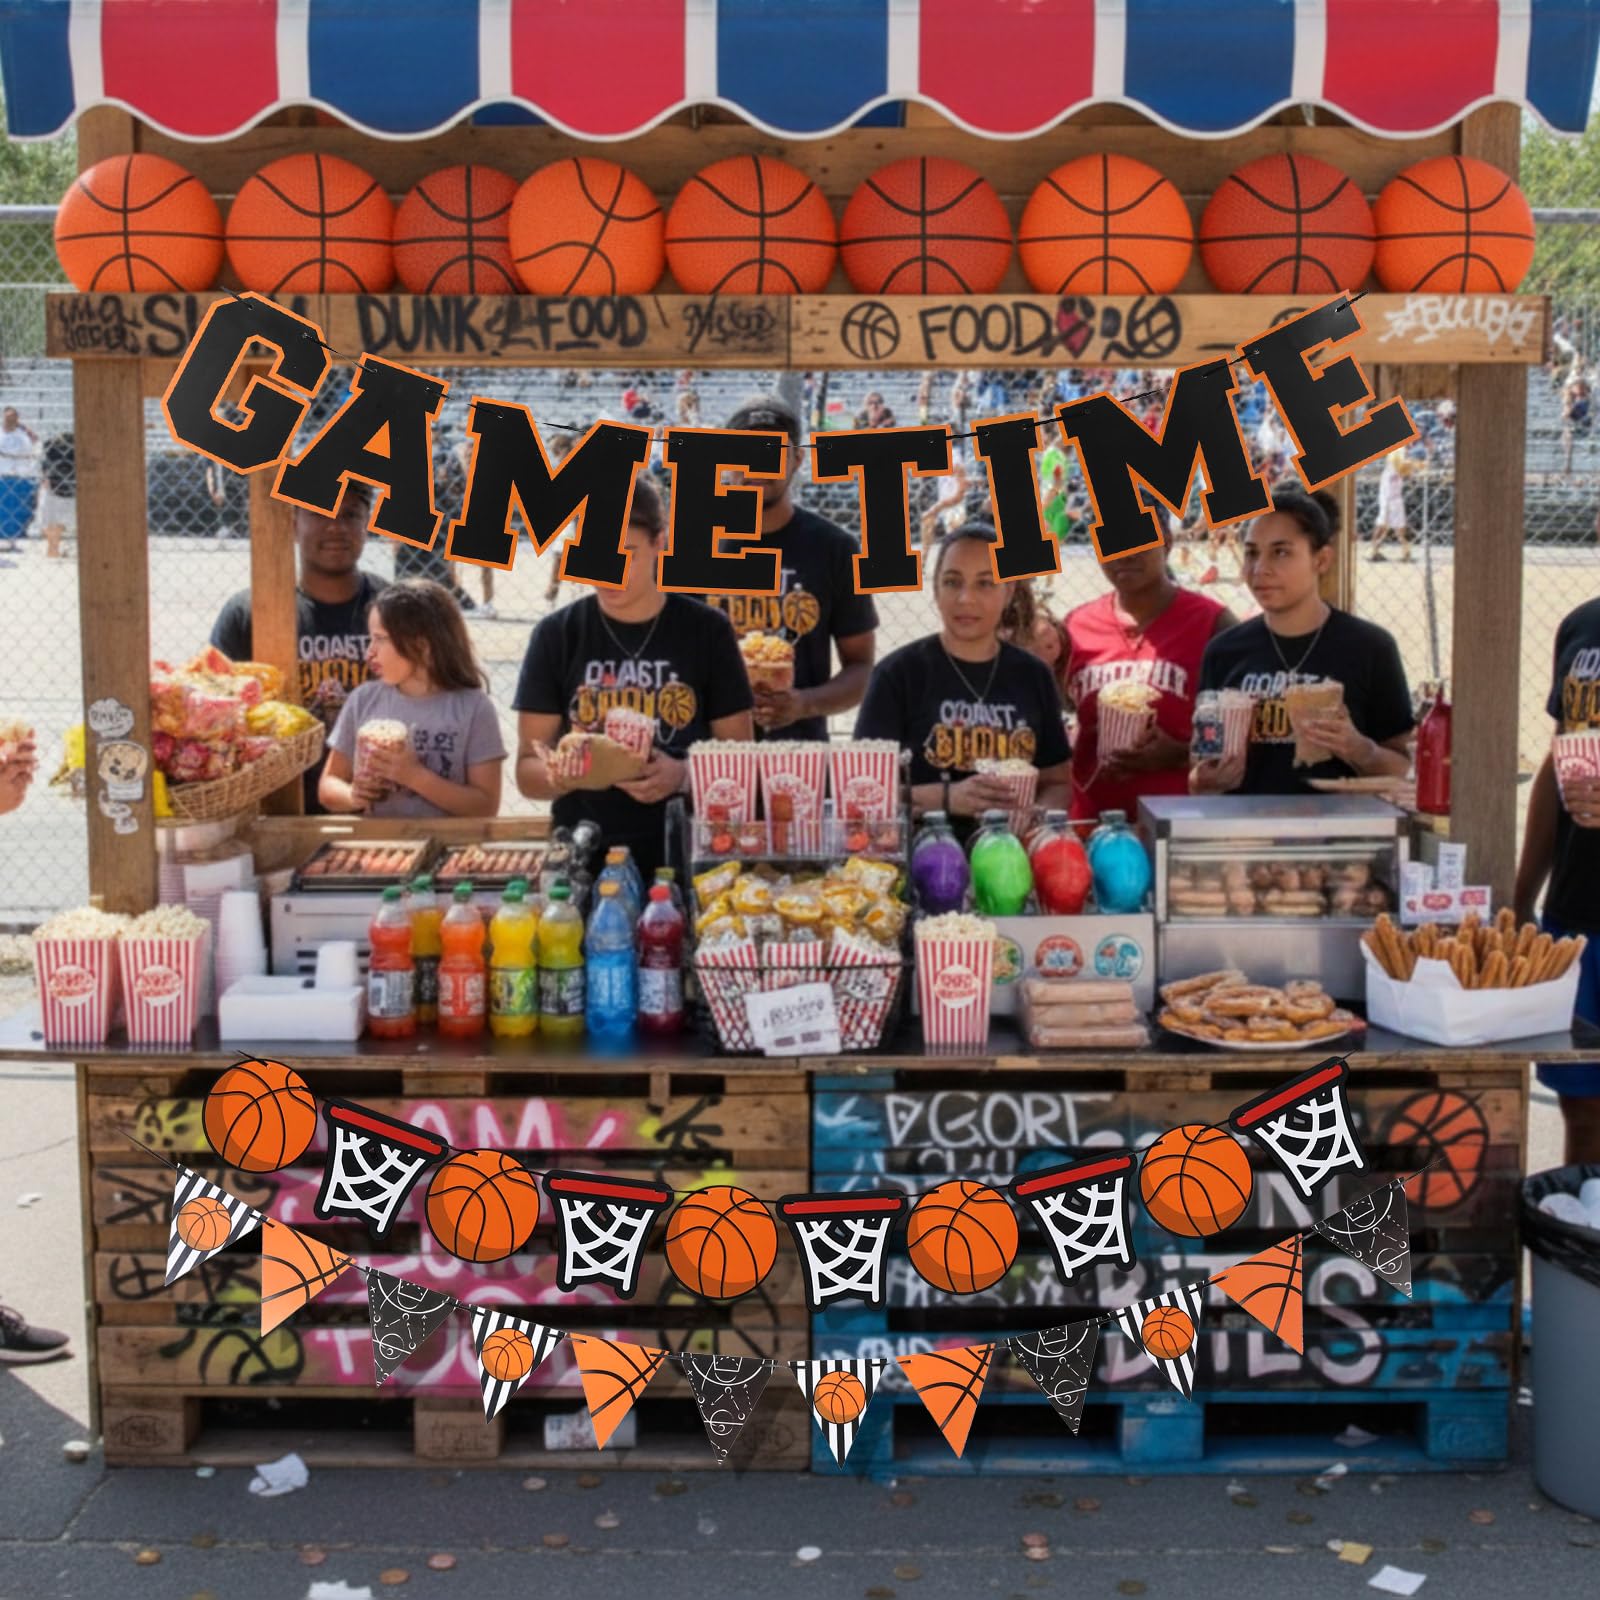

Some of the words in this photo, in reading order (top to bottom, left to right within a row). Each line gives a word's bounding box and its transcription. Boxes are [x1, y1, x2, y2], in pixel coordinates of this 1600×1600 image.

[355, 295, 486, 353] DUNK
[530, 294, 648, 351] FOOD
[918, 300, 1053, 361] FOOD
